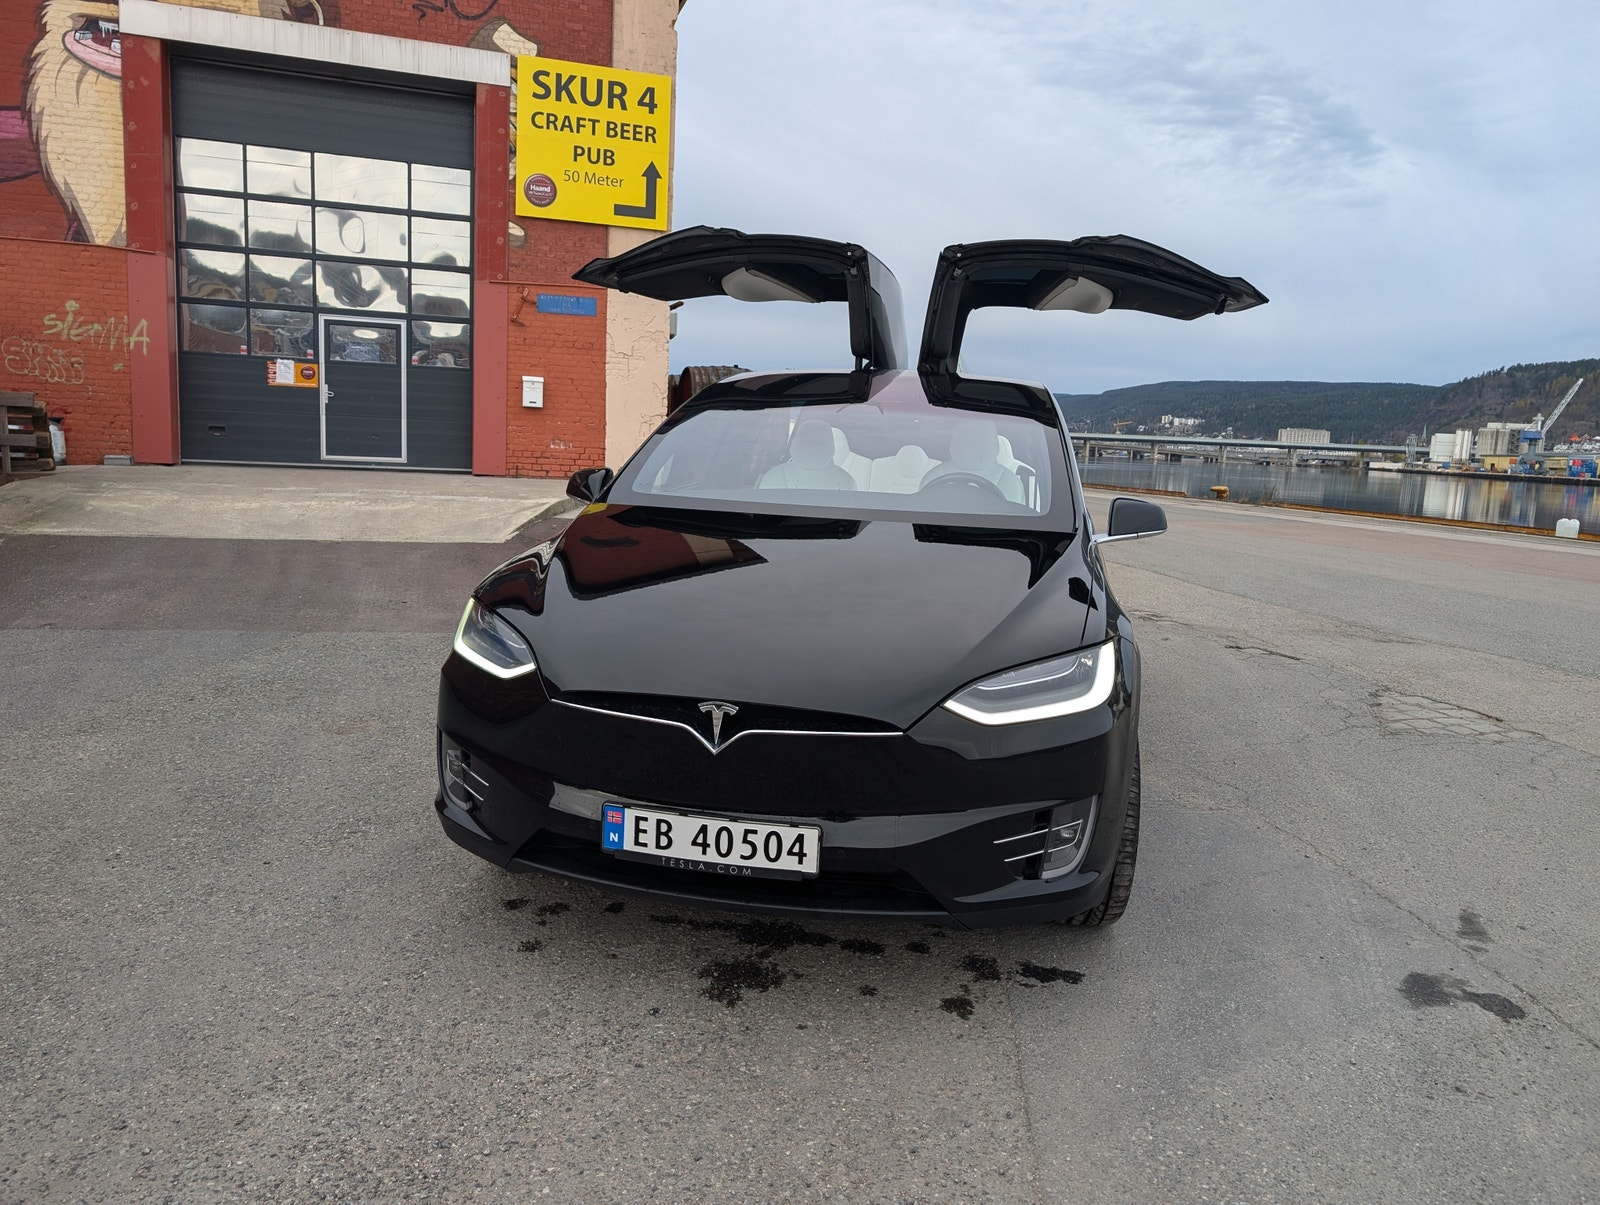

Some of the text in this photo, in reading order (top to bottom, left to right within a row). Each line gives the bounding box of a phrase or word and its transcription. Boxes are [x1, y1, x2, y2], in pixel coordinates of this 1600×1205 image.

[532, 70, 658, 114] SKUR 4
[531, 111, 657, 144] CRAFT BEER
[573, 145, 616, 166] PUB
[530, 184, 550, 192] Haand
[563, 169, 580, 183] 50
[584, 172, 624, 188] Meter
[609, 832, 619, 843] N
[634, 815, 807, 865] EB 40504
[661, 857, 752, 876] TESLA.COM
